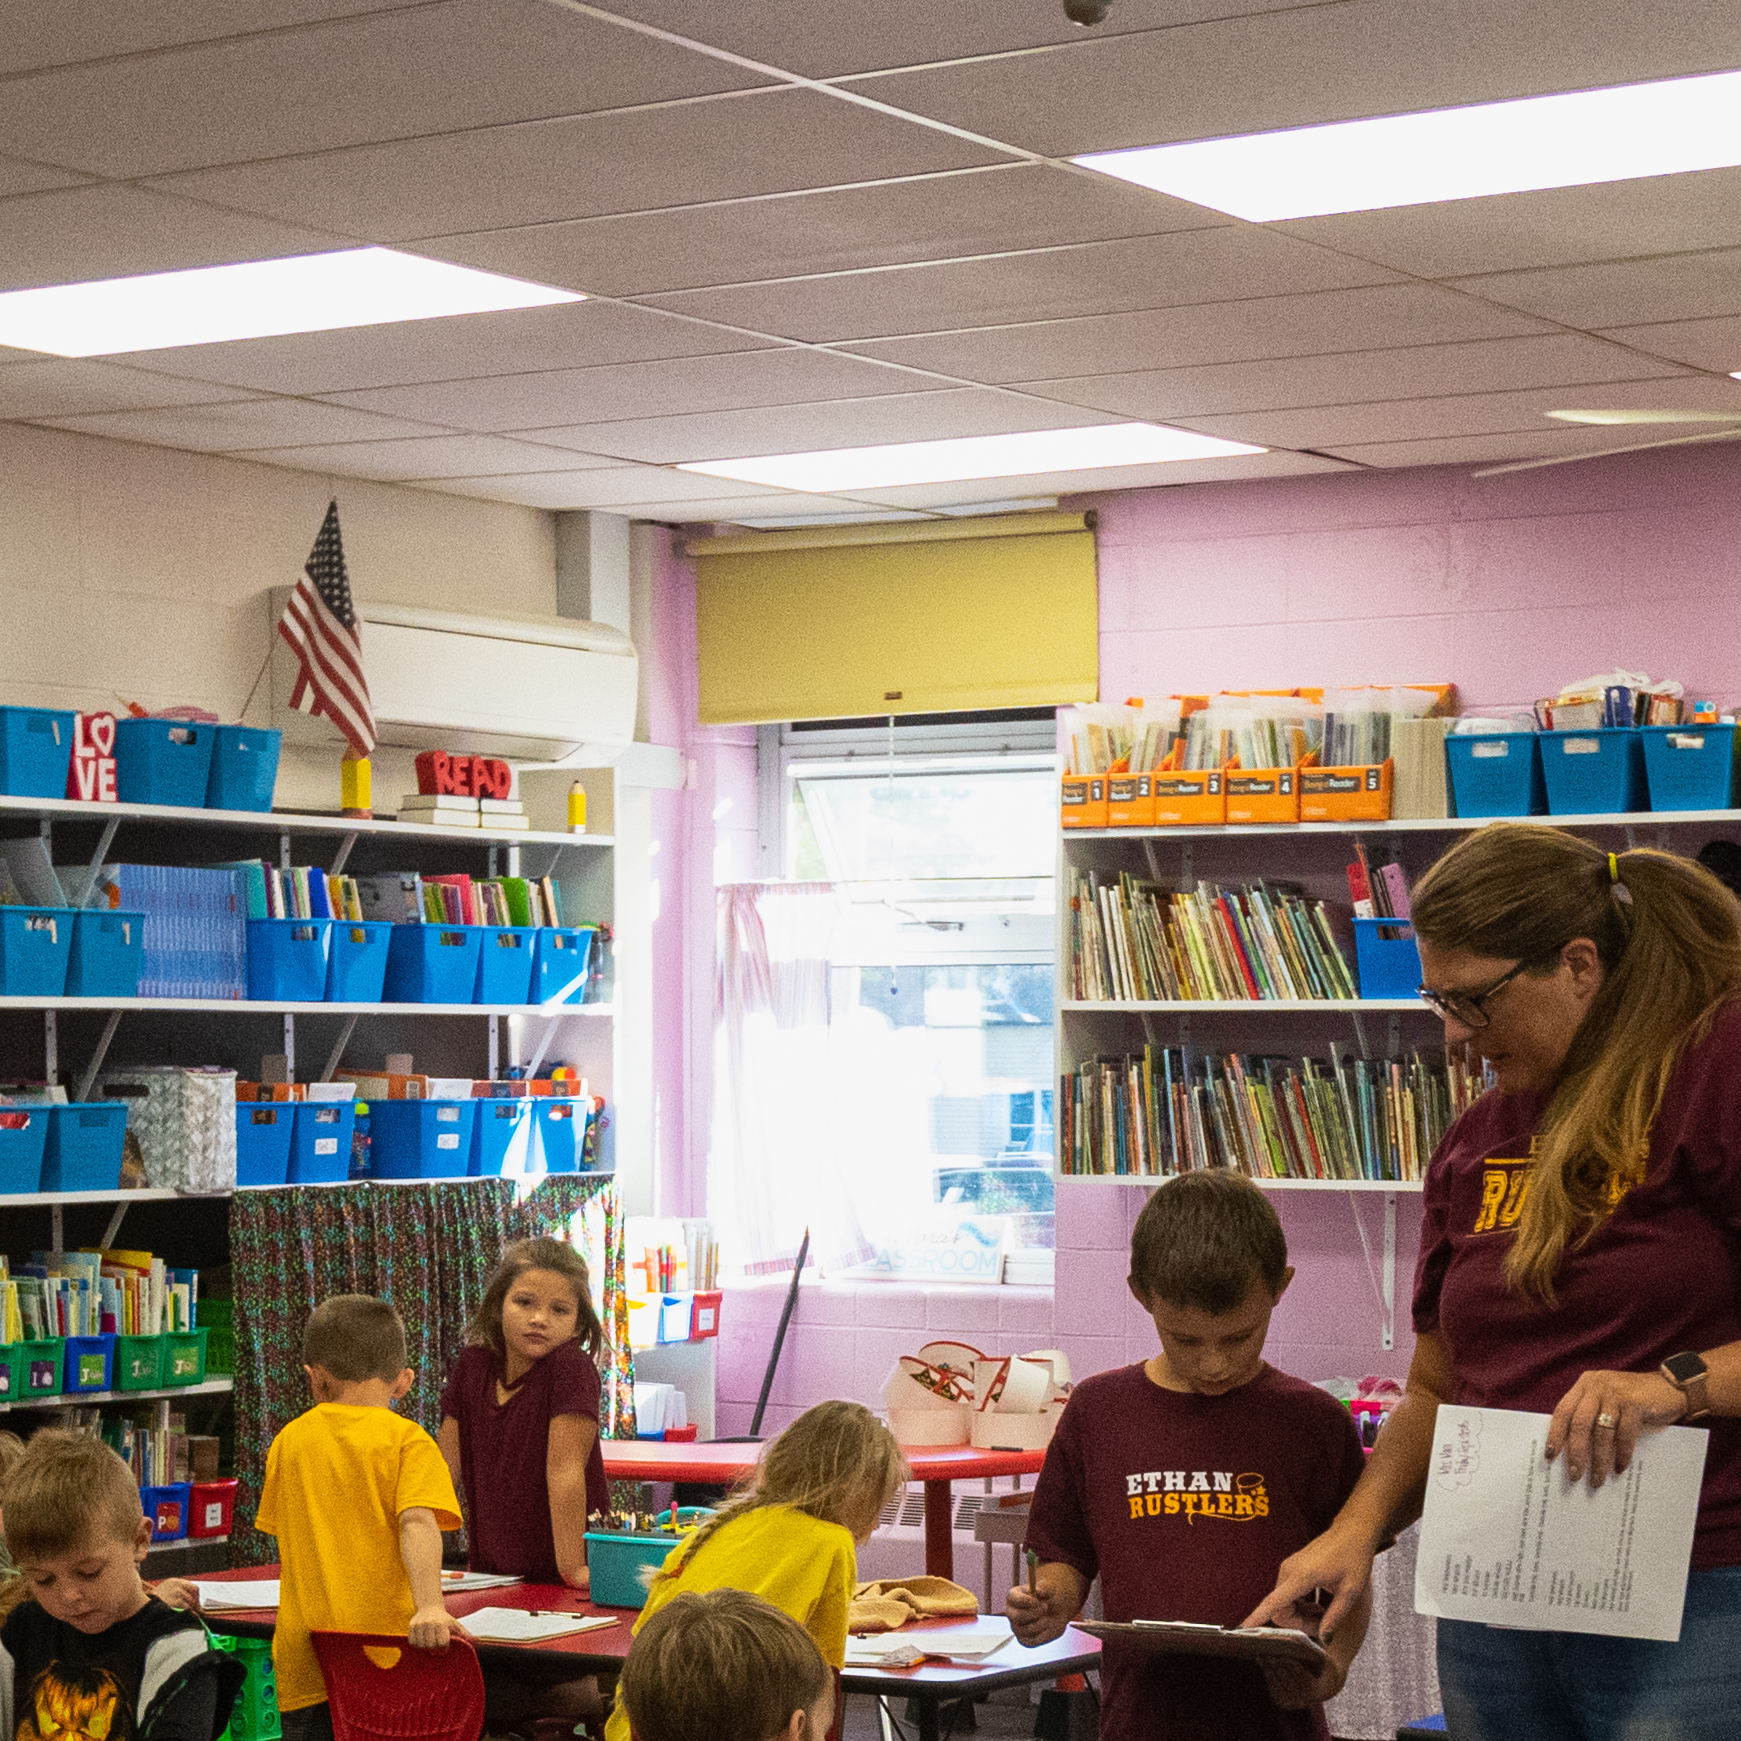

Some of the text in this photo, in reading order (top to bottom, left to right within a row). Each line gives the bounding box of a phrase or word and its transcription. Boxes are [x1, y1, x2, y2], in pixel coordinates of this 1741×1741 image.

[425, 750, 513, 800] READ
[1140, 784, 1148, 795] 2
[1210, 781, 1218, 792] 3
[1281, 782, 1290, 793] 4
[1329, 778, 1355, 788] Reader
[1368, 777, 1377, 789] 5
[80, 1368, 89, 1383] J
[1126, 1471, 1233, 1496] ETHAN
[1129, 1493, 1269, 1519] RUSTLERS
[158, 1516, 167, 1530] P
